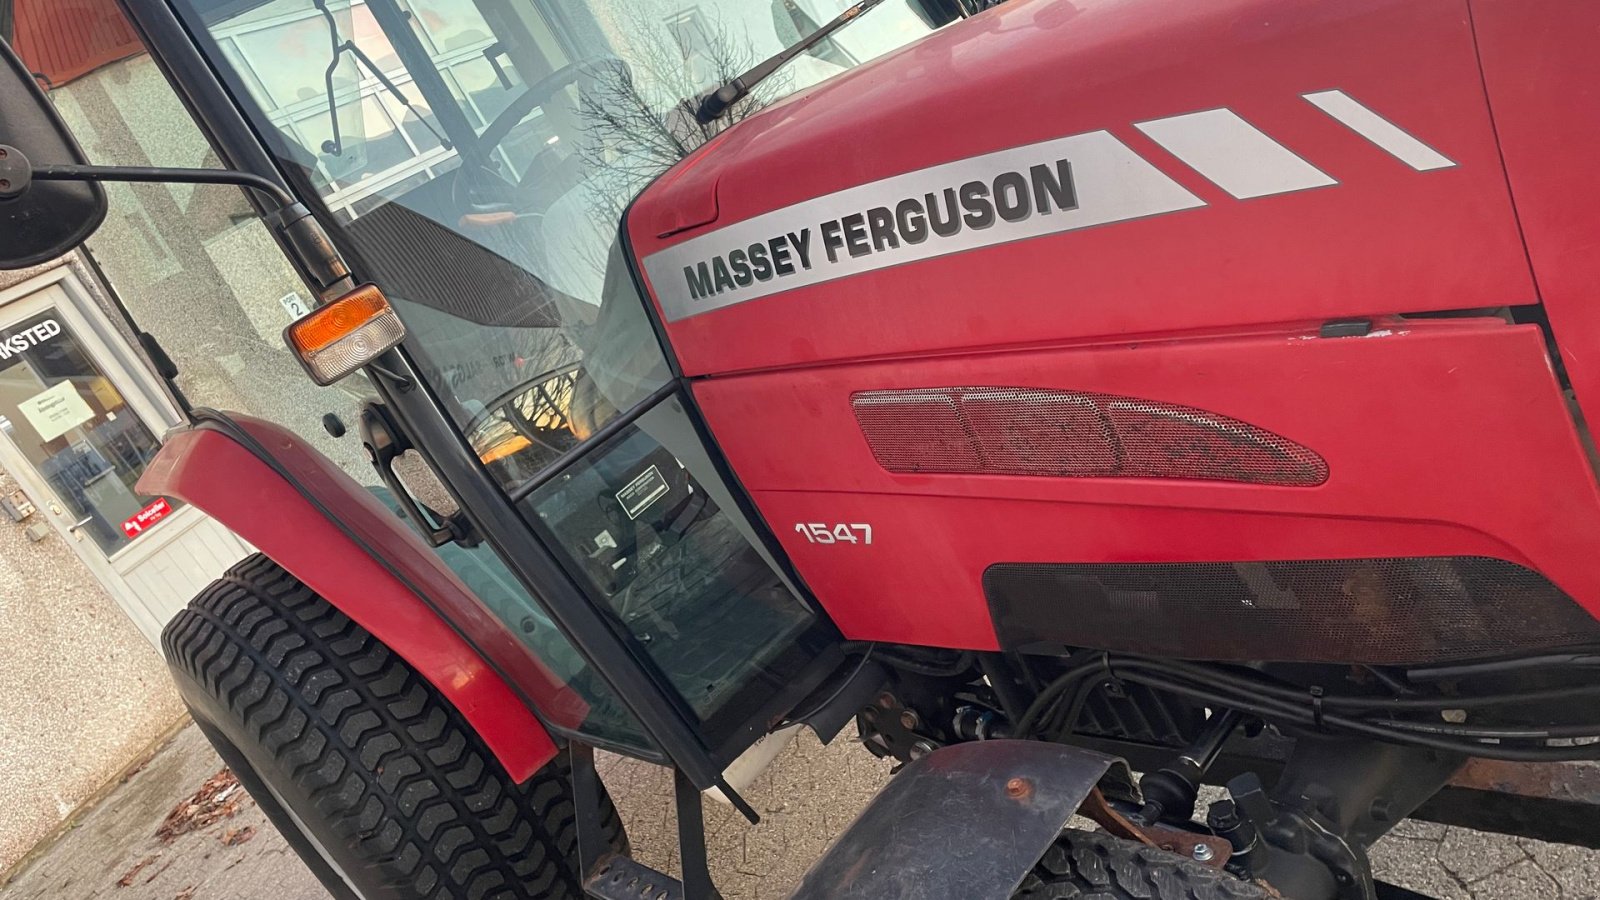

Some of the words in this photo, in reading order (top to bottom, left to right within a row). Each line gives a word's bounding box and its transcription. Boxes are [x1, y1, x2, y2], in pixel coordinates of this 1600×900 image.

[684, 228, 811, 300] MASSEY
[820, 159, 1080, 263] FERGUSON
[291, 303, 304, 316] 2
[795, 523, 872, 545] 1547
